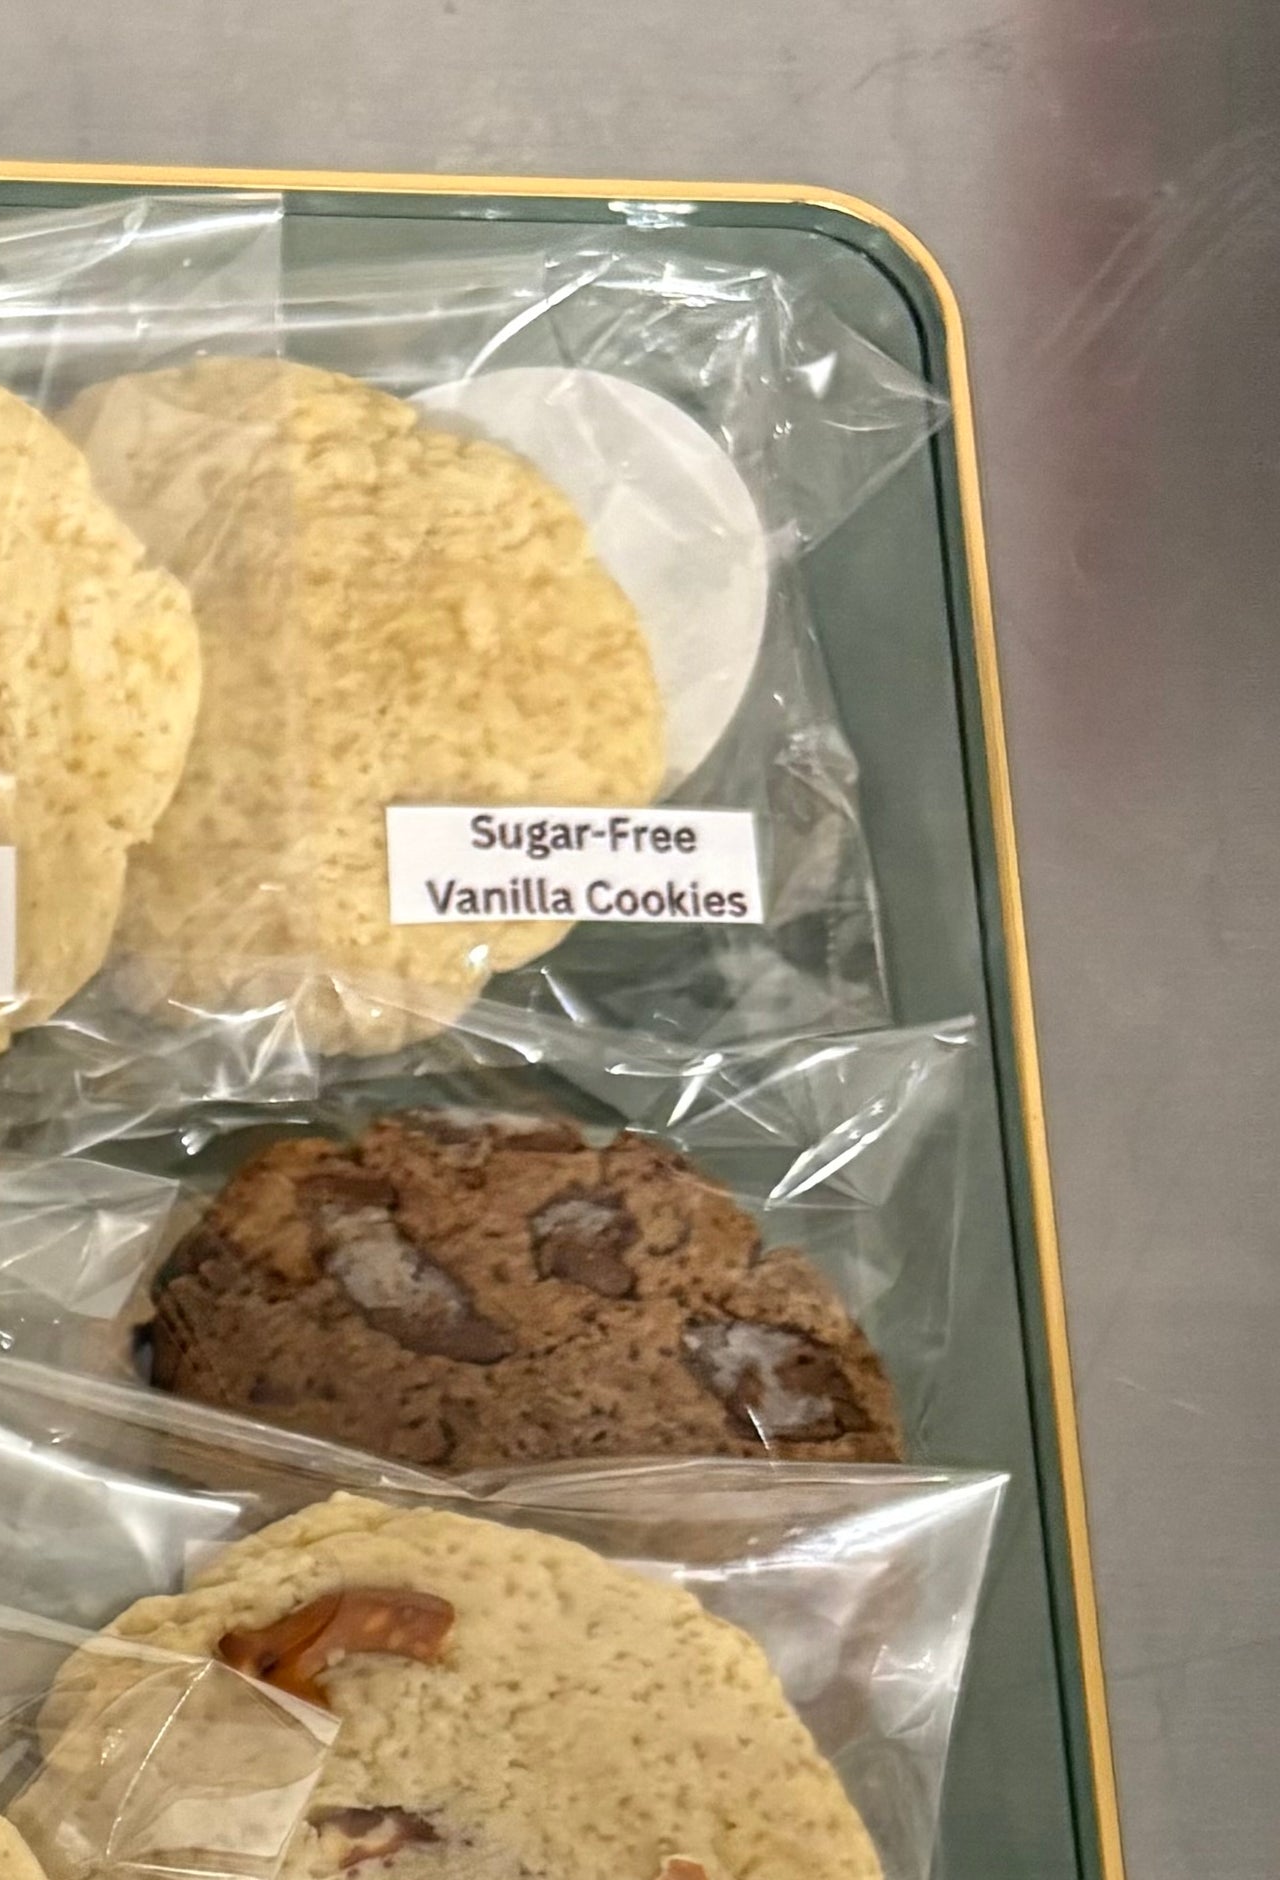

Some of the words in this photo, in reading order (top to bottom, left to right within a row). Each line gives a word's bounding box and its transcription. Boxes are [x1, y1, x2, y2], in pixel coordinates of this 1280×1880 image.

[470, 815, 697, 859] Sugar-Free
[425, 878, 575, 915] Vanilla
[586, 880, 748, 918] Cookies
